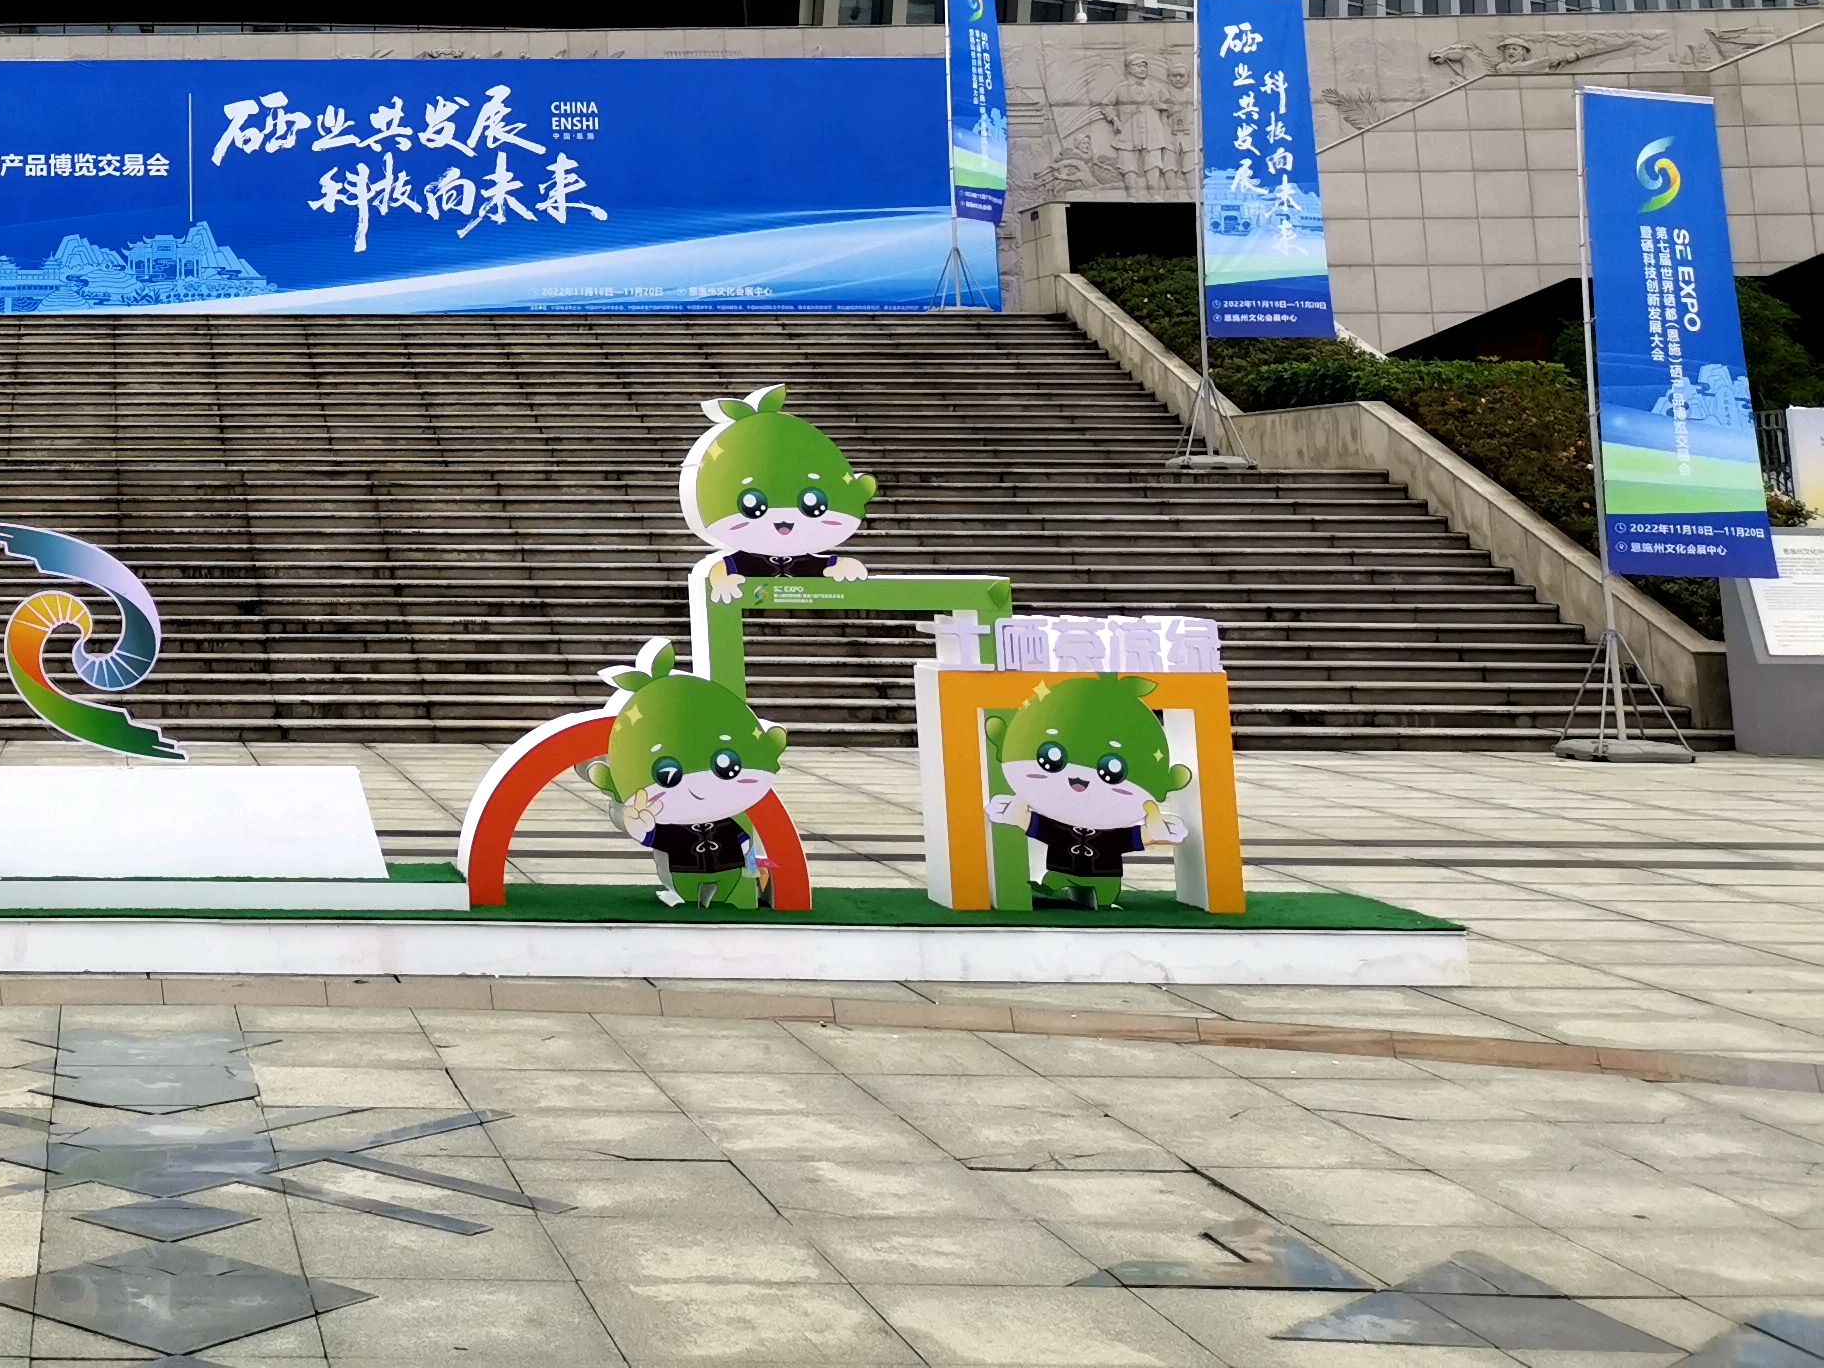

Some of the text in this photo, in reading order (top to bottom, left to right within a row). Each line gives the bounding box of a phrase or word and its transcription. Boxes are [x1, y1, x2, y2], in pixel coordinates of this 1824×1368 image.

[983, 52, 993, 91] EXPO
[211, 84, 547, 166] 硒业共发展
[551, 101, 598, 114] CHINA
[552, 117, 599, 130] ENSHI
[1219, 21, 1269, 197] 硒业共发展
[1260, 70, 1308, 257] 科技向未来
[307, 151, 608, 253] 科技向未来
[1639, 225, 1665, 363] 暨硒科技创新发展大会
[1678, 265, 1701, 332] EXPO
[1630, 542, 1727, 555] 恩施州文化会展中心
[939, 616, 1222, 672] 土硒茶凉绿
